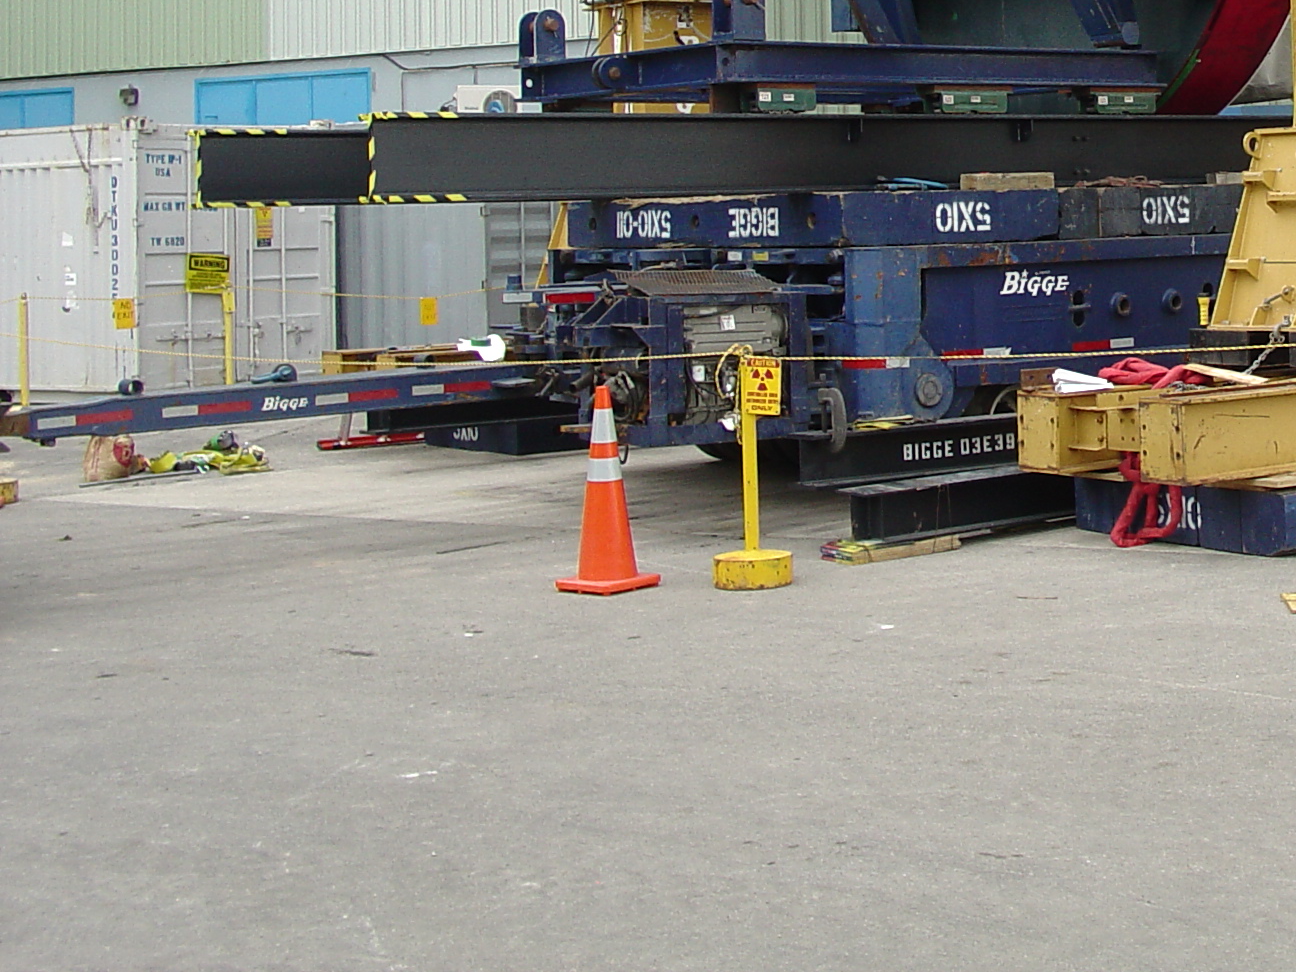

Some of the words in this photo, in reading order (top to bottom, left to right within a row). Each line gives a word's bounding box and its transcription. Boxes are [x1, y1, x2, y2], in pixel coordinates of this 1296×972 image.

[145, 153, 166, 165] TYPE
[155, 168, 171, 177] USA
[143, 202, 159, 212] MAX
[728, 207, 779, 238] BIGGE
[150, 237, 162, 247] TW
[193, 259, 226, 270] WARNING
[902, 439, 953, 461] BIGGE
